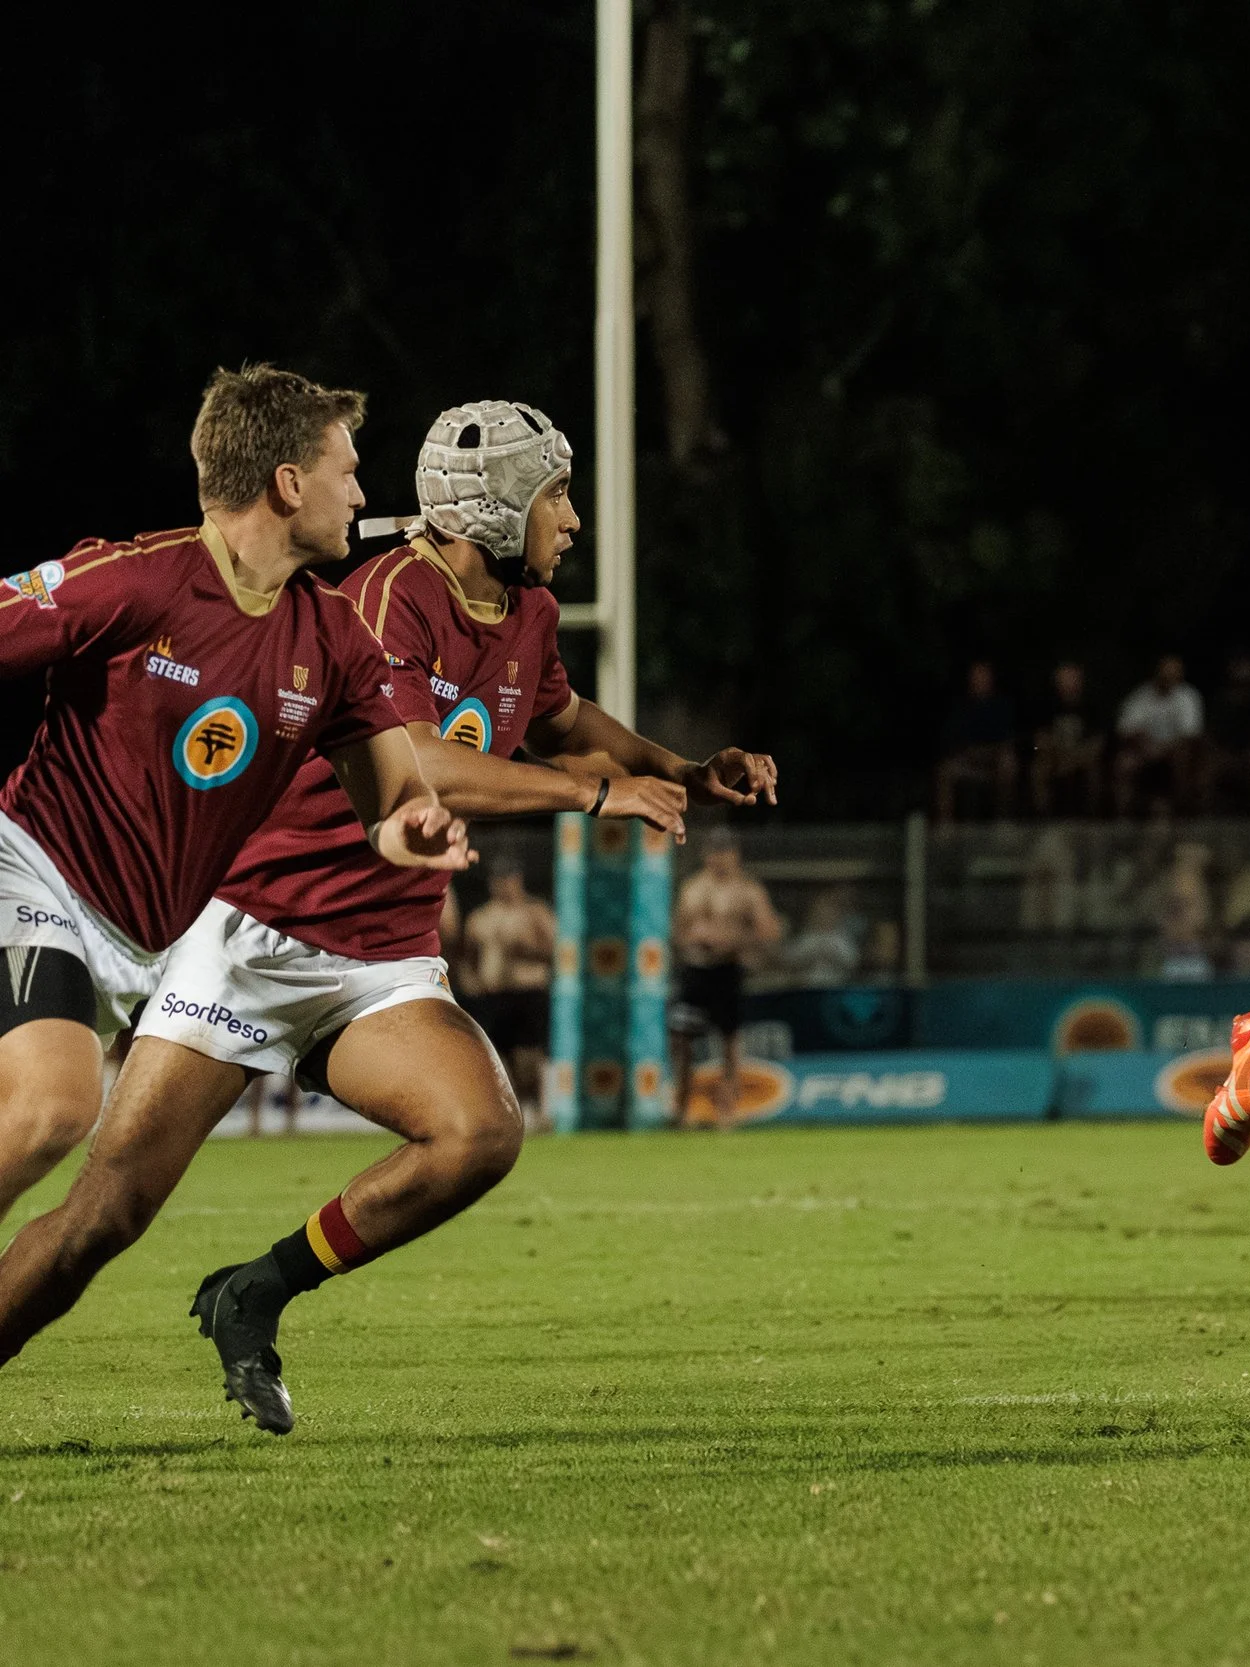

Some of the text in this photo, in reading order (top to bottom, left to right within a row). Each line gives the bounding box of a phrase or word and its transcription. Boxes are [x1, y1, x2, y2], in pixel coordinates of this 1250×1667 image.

[147, 655, 200, 687] STEERS
[429, 676, 460, 701] TEERS
[161, 992, 268, 1045] SportPesa
